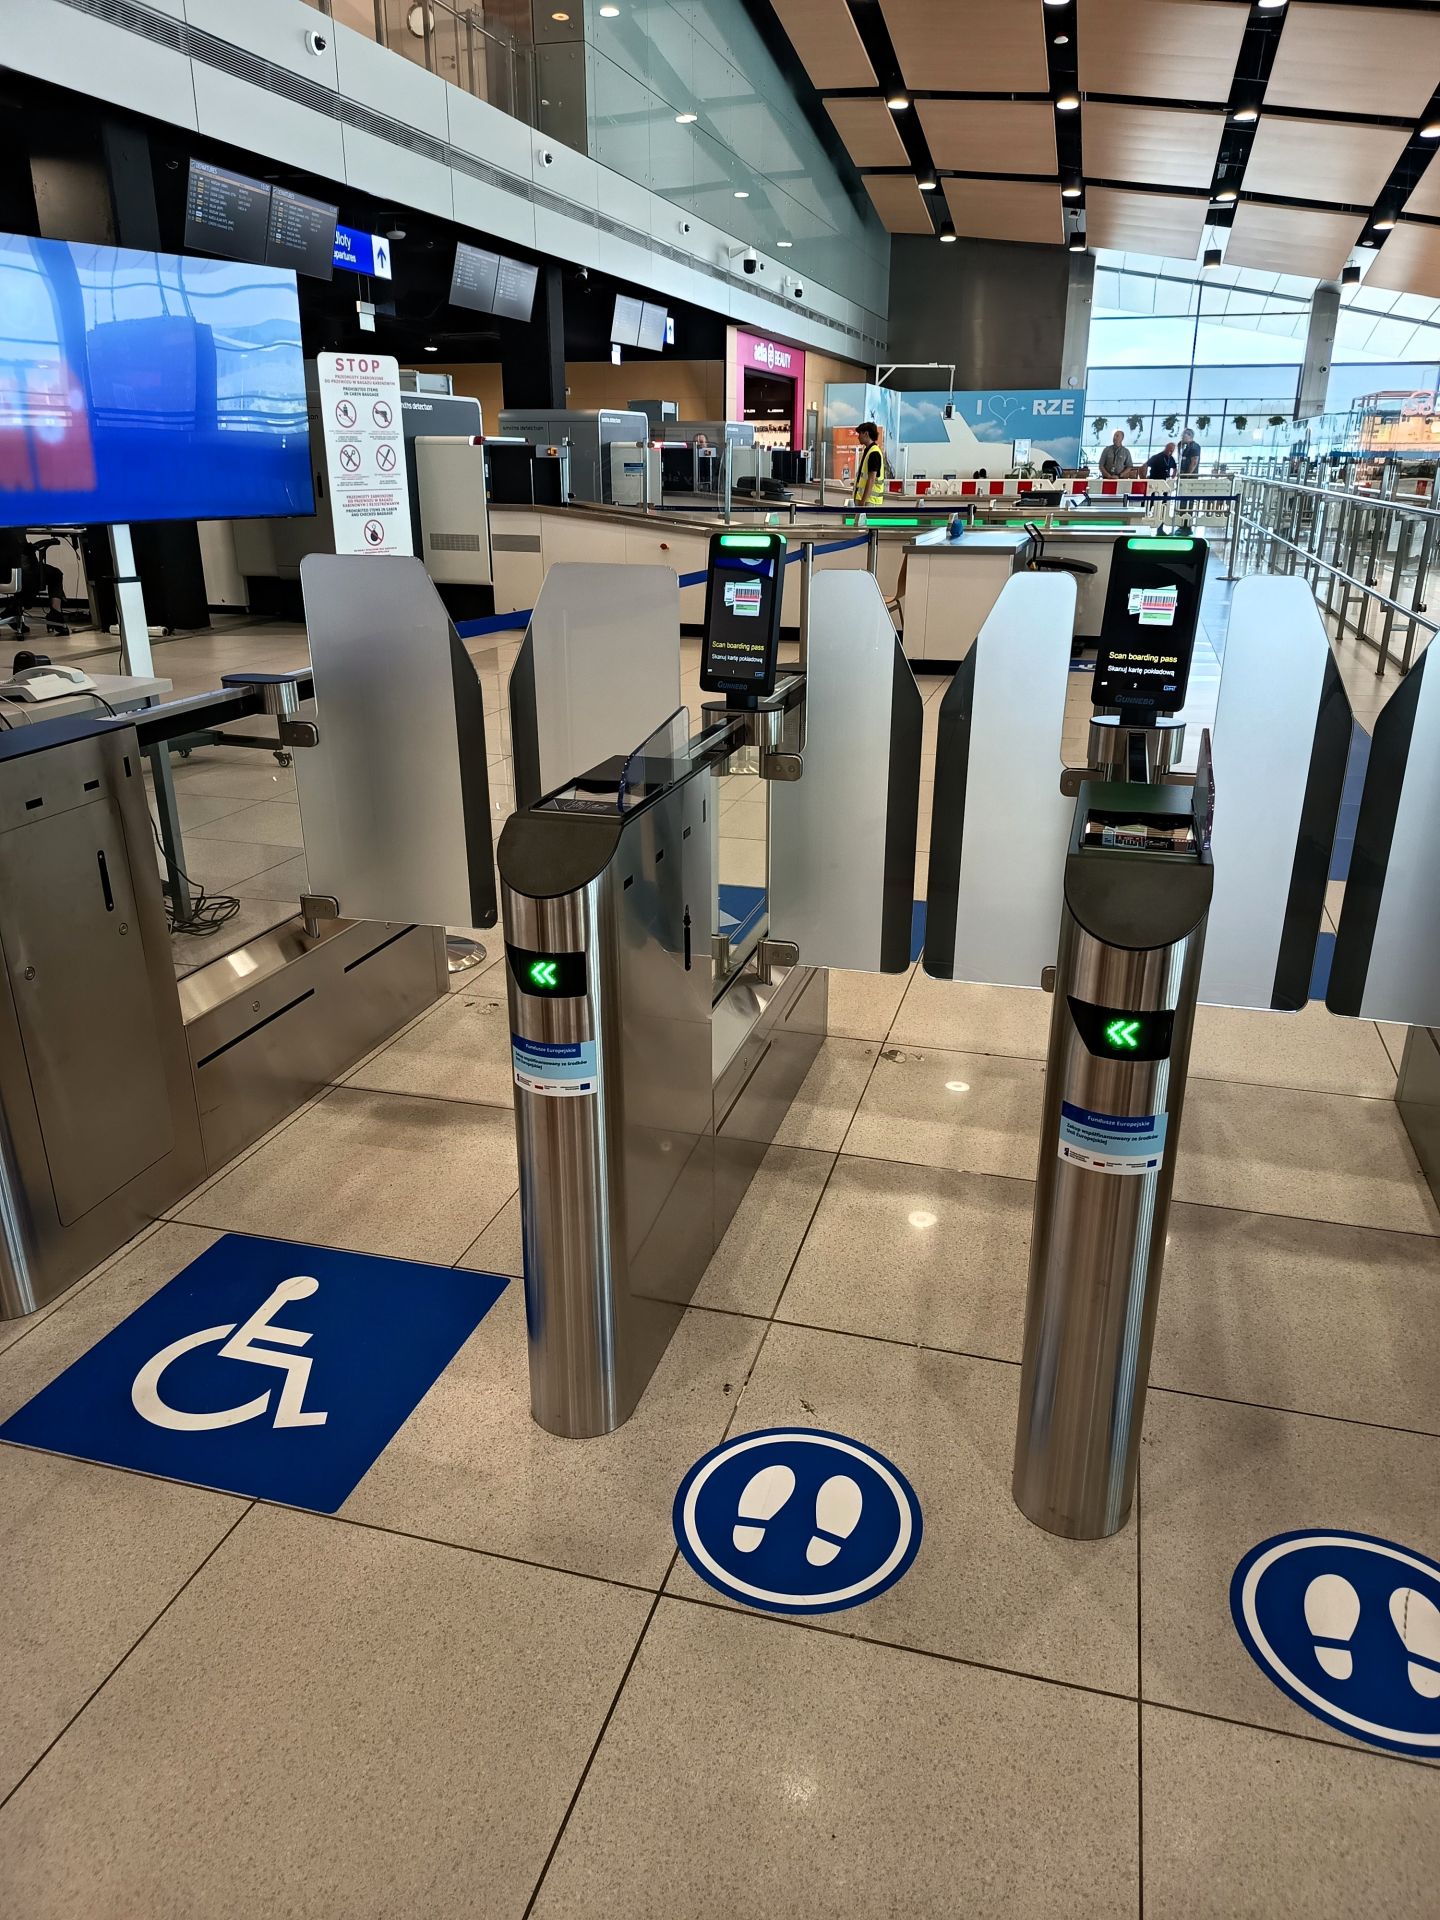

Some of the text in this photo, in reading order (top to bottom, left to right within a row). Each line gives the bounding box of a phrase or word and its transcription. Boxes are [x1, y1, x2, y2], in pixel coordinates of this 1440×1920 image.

[775, 350, 791, 368] BEAUTY
[336, 358, 380, 373] STOP
[1032, 400, 1075, 416] RZE
[712, 641, 726, 649] Scan
[727, 642, 750, 651] boarding
[712, 653, 727, 662] Skanuj
[1128, 653, 1159, 663] boarding
[1108, 665, 1127, 674] Skanuj
[526, 1044, 546, 1052] Fundusze
[1087, 1115, 1115, 1126] Fundusze
